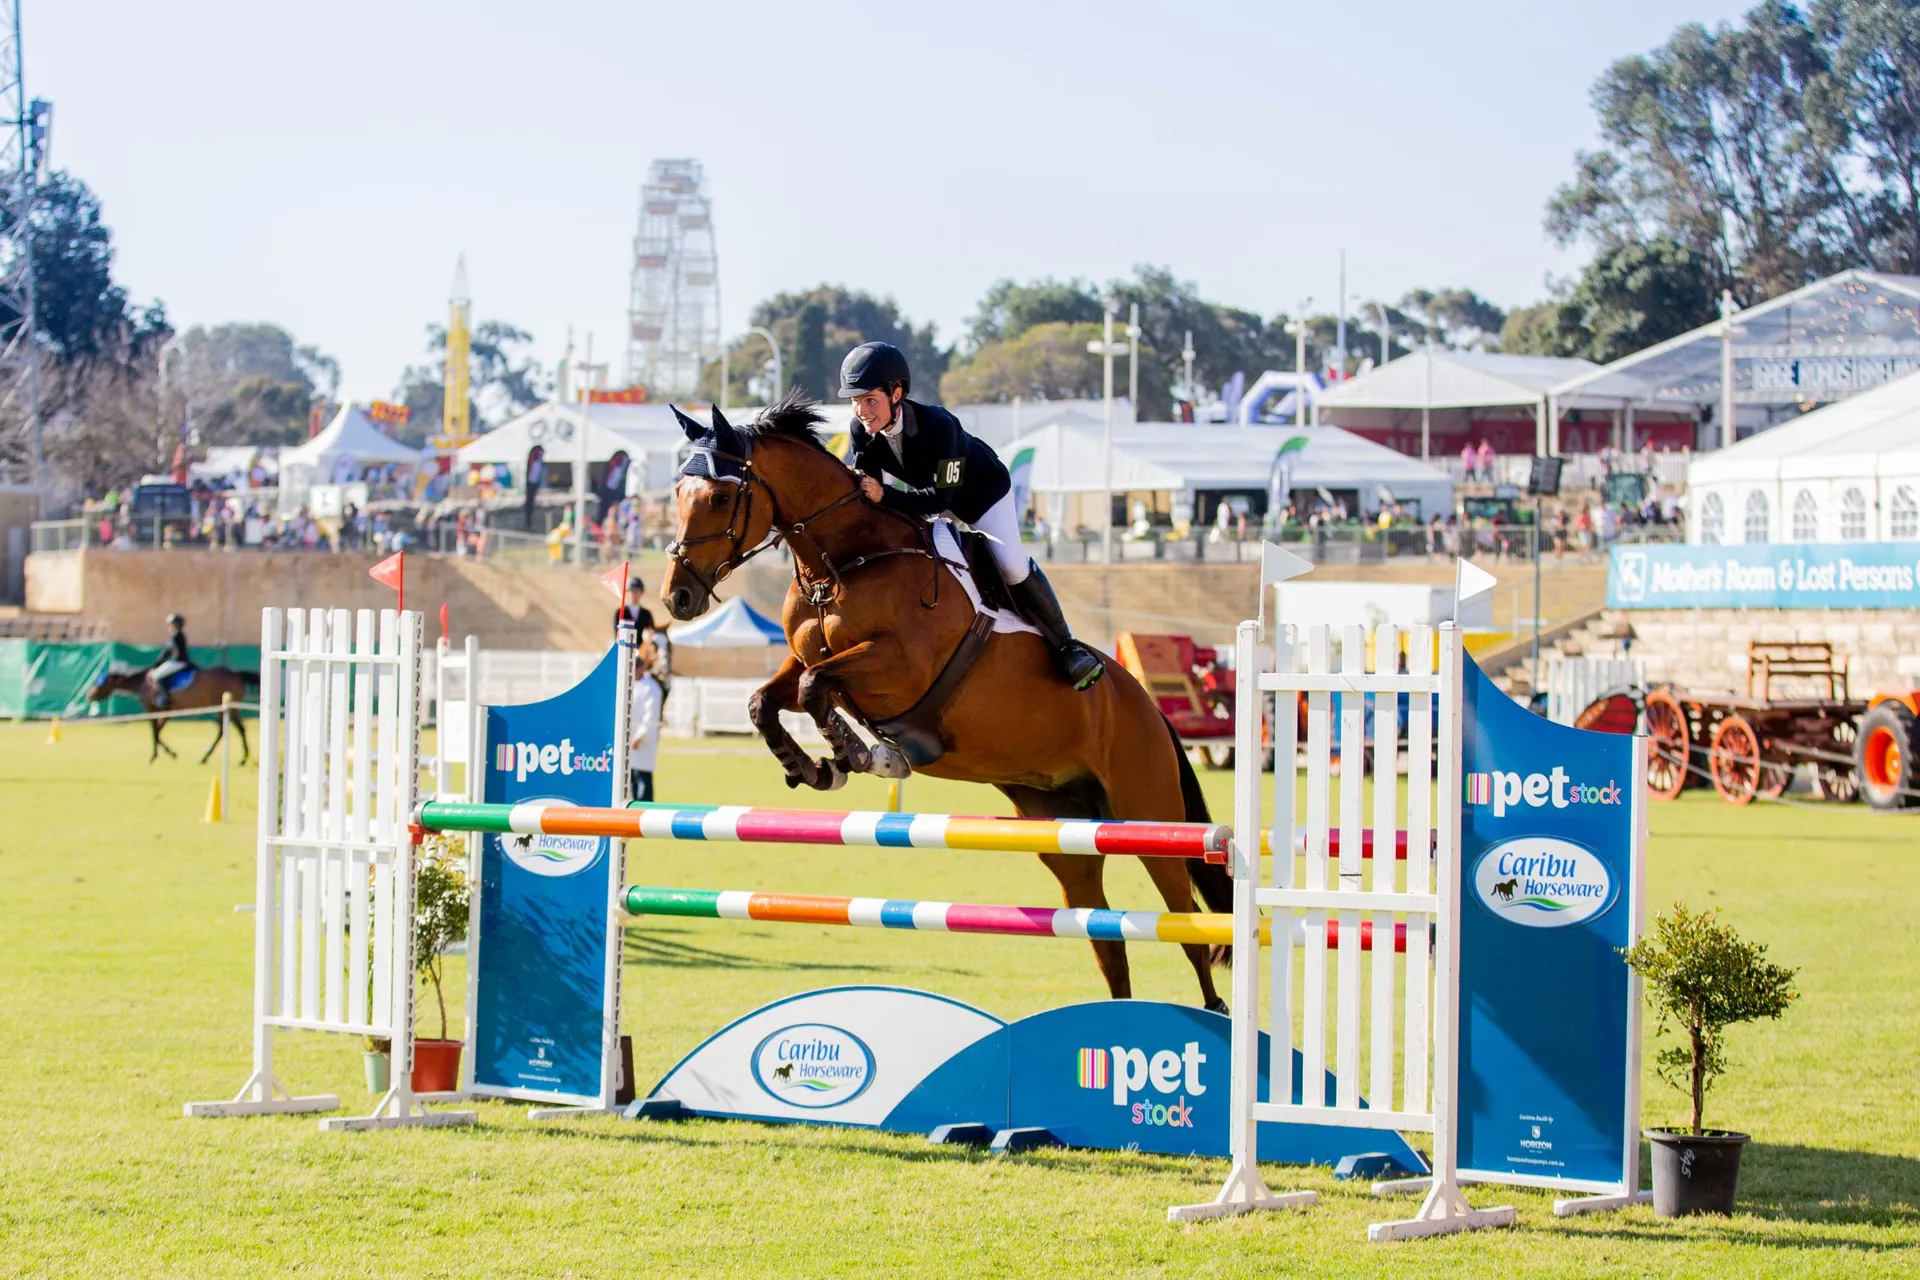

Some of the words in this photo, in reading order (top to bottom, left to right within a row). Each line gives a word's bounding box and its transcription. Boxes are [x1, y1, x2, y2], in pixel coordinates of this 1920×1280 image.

[946, 461, 960, 484] 05
[1724, 559, 1776, 592] Room
[1779, 558, 1795, 593] &
[1796, 559, 1837, 592] Lost
[1838, 558, 1914, 592] Persons
[516, 738, 574, 783] pet
[573, 750, 611, 772] stock
[1492, 766, 1570, 817] pet
[1569, 780, 1621, 804] stock
[538, 834, 596, 851] Horseware
[1498, 852, 1576, 877] Caribu
[1524, 879, 1604, 898] Horseware
[778, 1039, 840, 1061] Caribu
[800, 1063, 863, 1079] Horseware
[1110, 1041, 1207, 1106] pet
[1132, 1095, 1193, 1128] stock
[1520, 1140, 1552, 1150] HORIZON
